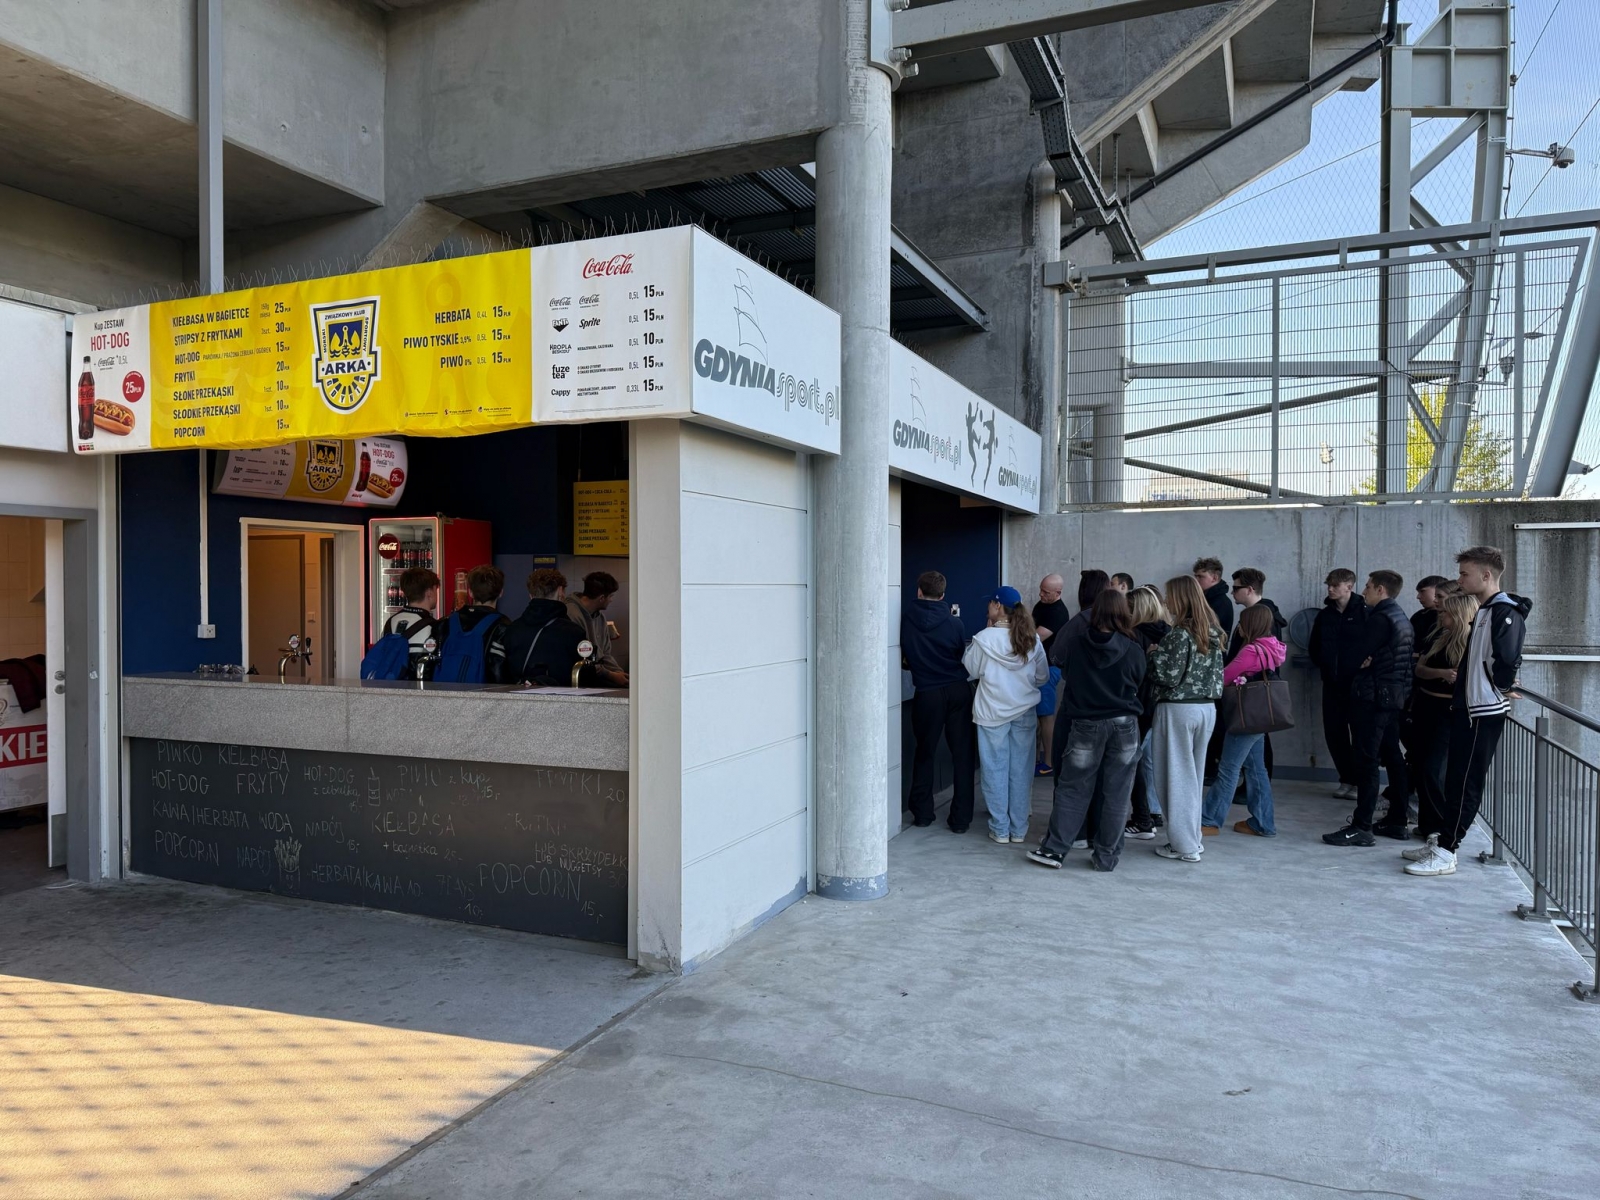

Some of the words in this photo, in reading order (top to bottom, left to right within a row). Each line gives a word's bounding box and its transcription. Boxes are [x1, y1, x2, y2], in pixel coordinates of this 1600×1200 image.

[582, 253, 635, 279] Coca-Cola
[578, 294, 600, 305] Coca-Cola
[628, 291, 640, 300] 0,5L
[643, 284, 655, 298] 15
[94, 322, 103, 331] Kup
[103, 318, 125, 330] ZESTAW
[172, 314, 205, 328] KIEŁBASA
[206, 312, 215, 323] W
[215, 307, 250, 322] BAGIETCE
[274, 302, 284, 314] 25
[324, 311, 353, 321] ZWIĄZKOWY
[434, 308, 471, 324] HERBATA
[492, 305, 503, 318] 15
[578, 317, 601, 329] Sprite
[628, 314, 640, 324] 0,5L
[643, 308, 655, 322] 15
[90, 331, 130, 351] HOT-DOG
[174, 332, 199, 346] STRIPSY
[200, 332, 205, 342] Z
[206, 327, 243, 342] FRYTKAMI
[275, 321, 285, 333] 30
[403, 336, 429, 349] PIWO
[430, 333, 459, 347] TYSKIE
[492, 329, 503, 341] 15
[628, 338, 640, 347] 0,5L
[643, 332, 655, 345] 10
[174, 351, 200, 365] HOT-DOG
[276, 341, 285, 352] 15
[440, 355, 463, 368] PIWO
[492, 352, 503, 364] 15
[174, 371, 195, 383] FRYTKI
[276, 361, 285, 372] 20
[324, 359, 367, 376] ARKA
[552, 363, 570, 373] fuze
[628, 361, 640, 370] 0,5L
[643, 355, 655, 369] 15
[125, 381, 135, 394] 25
[173, 389, 195, 401] SŁONE
[195, 386, 234, 400] PRZEKĄSKI
[276, 380, 284, 391] 10
[551, 388, 571, 397] Cappy
[643, 378, 655, 392] 15
[173, 407, 202, 420] SŁODKIE
[202, 403, 241, 418] PRZEKĄSKI
[276, 400, 284, 411] 10
[174, 426, 205, 438] POPCORN
[276, 419, 284, 430] 15
[372, 448, 395, 459] HOT-DOG
[312, 465, 338, 475] ARKA
[378, 542, 398, 551] Coca-Cola
[156, 740, 203, 766] PIWKO
[151, 768, 211, 795] HOT-DOG
[303, 764, 355, 784] HOT-DOG
[154, 829, 220, 867] POPCORN
[475, 861, 582, 903] POPCORN
